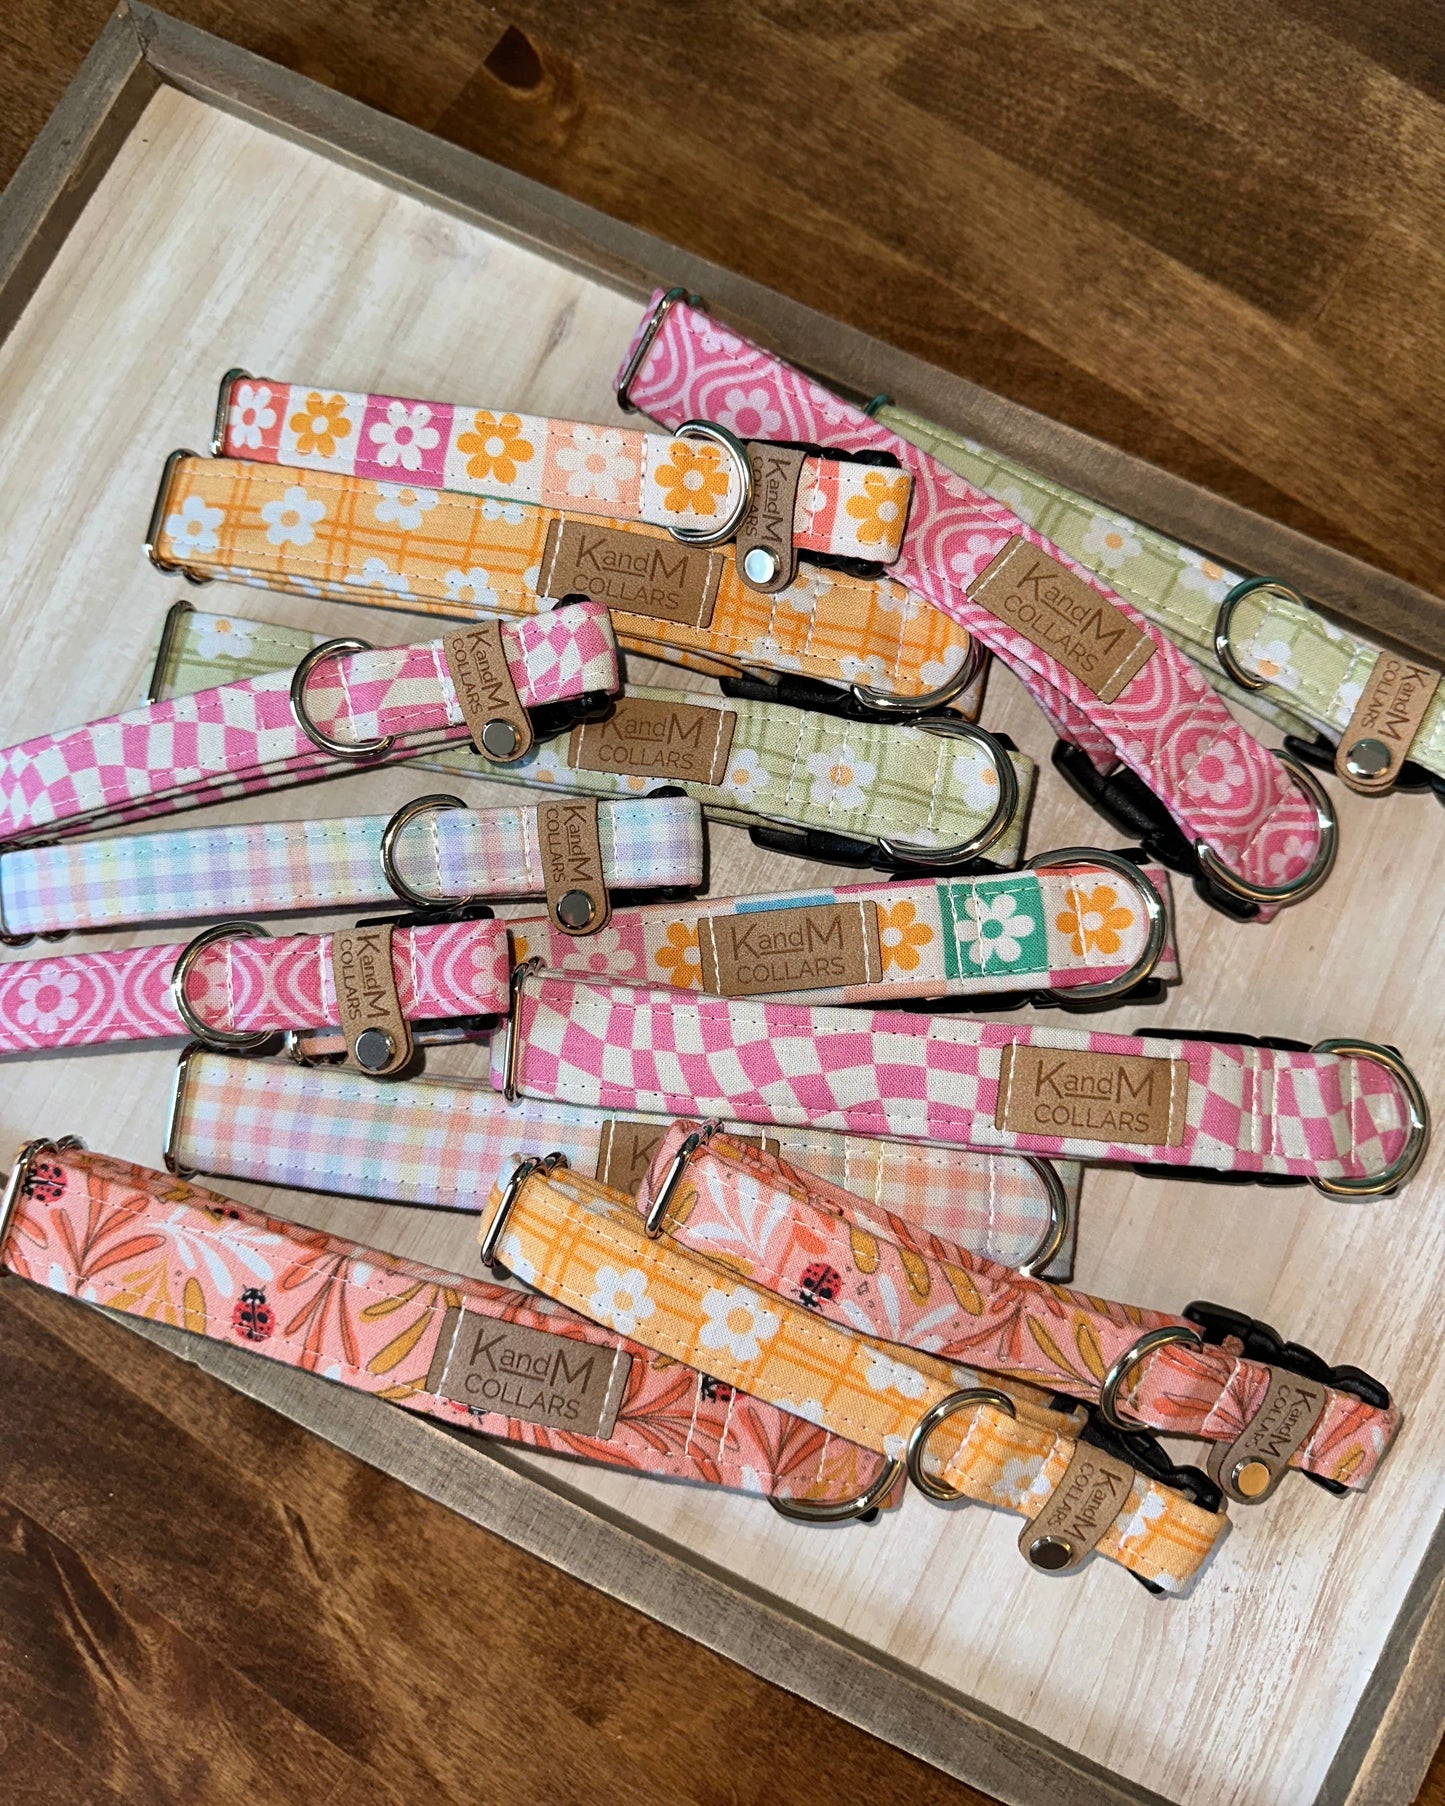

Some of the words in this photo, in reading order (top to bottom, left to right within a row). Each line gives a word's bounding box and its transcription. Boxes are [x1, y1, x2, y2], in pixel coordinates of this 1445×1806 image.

[746, 456, 764, 537] COLLARS
[761, 457, 791, 546] KandM
[574, 573, 680, 611] COLLARS
[576, 534, 687, 587] KandM
[1003, 594, 1097, 673] COLLARS
[1016, 561, 1126, 656] KandM
[450, 638, 484, 718] COLLARS
[467, 627, 510, 712] KandM
[1360, 660, 1400, 729] COLLARS
[1377, 665, 1431, 742] KandM
[598, 744, 695, 770] COLLARS
[601, 707, 704, 748] KandM
[544, 807, 564, 884] COLLARS
[562, 804, 594, 886] KandM
[731, 914, 845, 957] KandM
[340, 938, 363, 1021] COLLARS
[354, 933, 392, 1019] KandM
[737, 959, 847, 986] COLLARS
[1034, 1060, 1155, 1106] KandM
[1034, 1103, 1152, 1133] COLLARS
[470, 1327, 595, 1388] KandM
[464, 1373, 582, 1421] COLLARS
[1244, 1384, 1291, 1449] COLLARS
[1258, 1388, 1318, 1458] KandM
[1047, 1462, 1095, 1526] COLLARS
[1063, 1467, 1123, 1542] KandM
